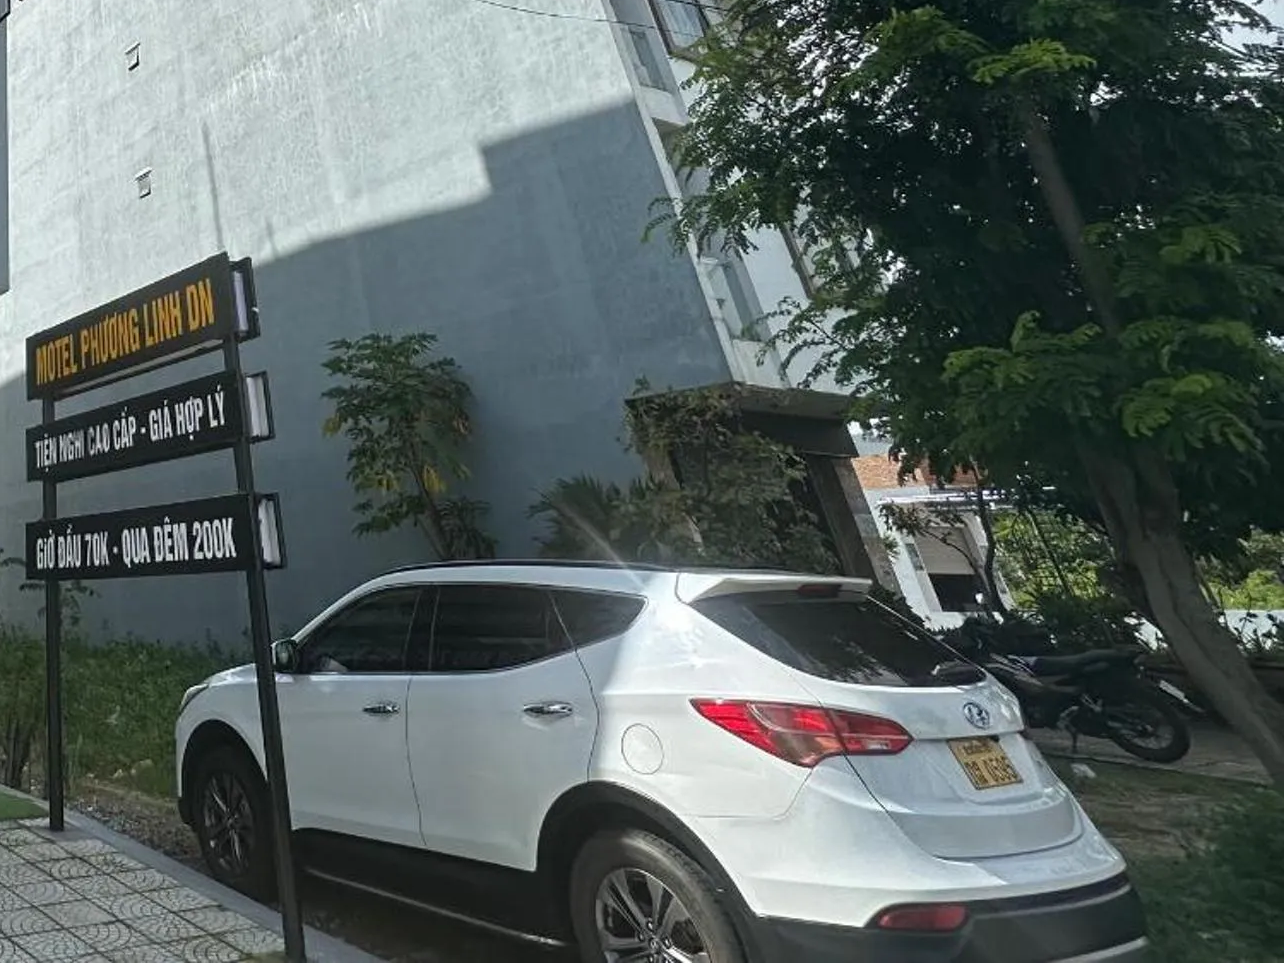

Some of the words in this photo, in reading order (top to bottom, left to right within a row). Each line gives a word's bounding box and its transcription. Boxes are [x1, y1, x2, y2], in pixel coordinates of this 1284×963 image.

[36, 334, 77, 385] MOTEL
[143, 291, 183, 347] LINH
[186, 278, 214, 332] DN
[59, 429, 85, 462] NGHI
[87, 422, 110, 456] CAO
[148, 399, 173, 441] GIÁ
[174, 396, 203, 440] HỢP
[207, 385, 225, 428] LÝ
[85, 531, 110, 566] 70K
[121, 527, 151, 568] QUA
[153, 516, 189, 561] ĐÊM
[192, 517, 237, 560] 200K
